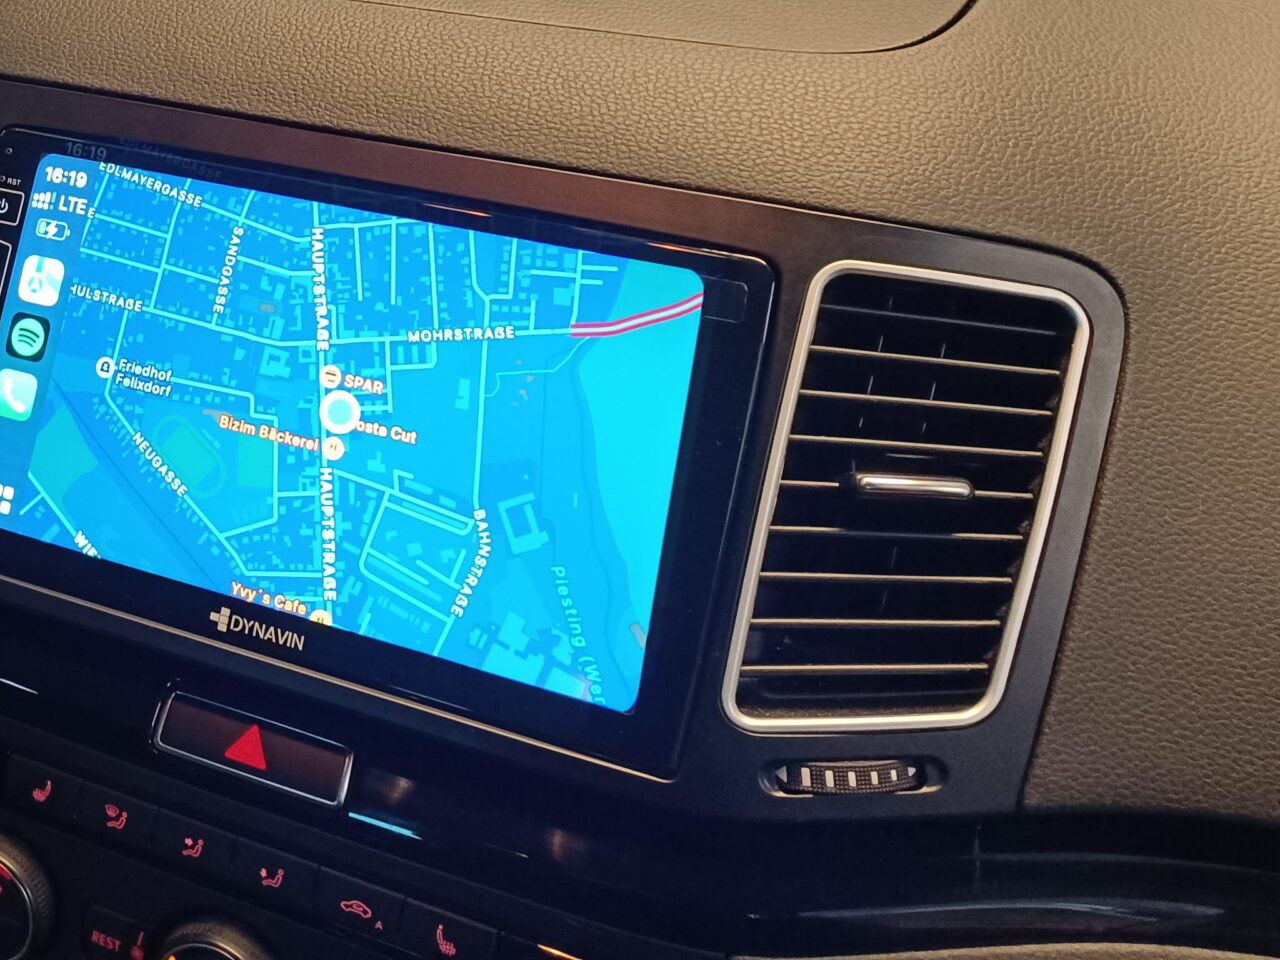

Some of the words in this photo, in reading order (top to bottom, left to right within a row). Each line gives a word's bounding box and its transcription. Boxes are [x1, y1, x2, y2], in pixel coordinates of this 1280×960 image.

[7, 177, 22, 186] RST
[45, 166, 88, 188] 16:19
[99, 161, 202, 208] EDLMAYERGASSE
[58, 194, 88, 215] LTE
[213, 225, 245, 315] SANDGASSE
[118, 358, 172, 382] Friedhof
[115, 373, 172, 397] Felixdorf
[344, 373, 384, 395] SPAR
[219, 415, 256, 436] Bizim
[259, 424, 320, 451] Bäckerei
[354, 420, 388, 438] osta
[390, 425, 418, 445] Cut
[131, 431, 189, 498] NEUGASSE
[274, 594, 307, 615] Cafe
[550, 566, 587, 647] Piesting
[230, 615, 305, 651] DYNAVIN
[91, 930, 121, 952] REST
